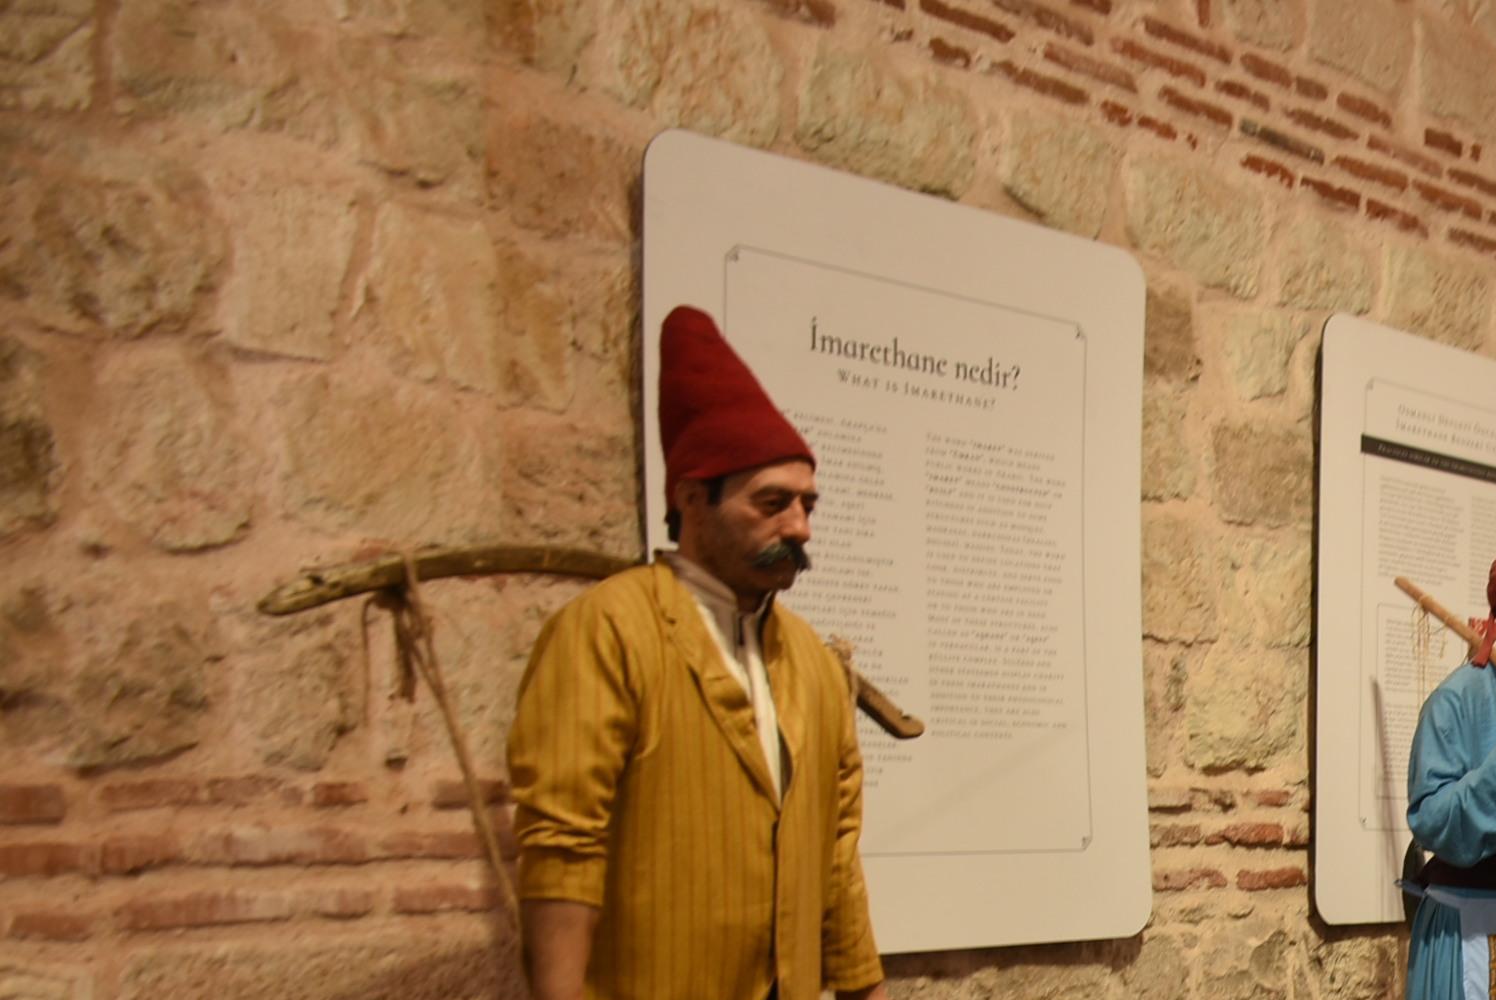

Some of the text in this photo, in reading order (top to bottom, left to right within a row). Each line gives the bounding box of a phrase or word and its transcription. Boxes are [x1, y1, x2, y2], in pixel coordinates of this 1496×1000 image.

[809, 316, 1021, 391] İmarethane nedir?
[836, 367, 879, 390] WHAT
